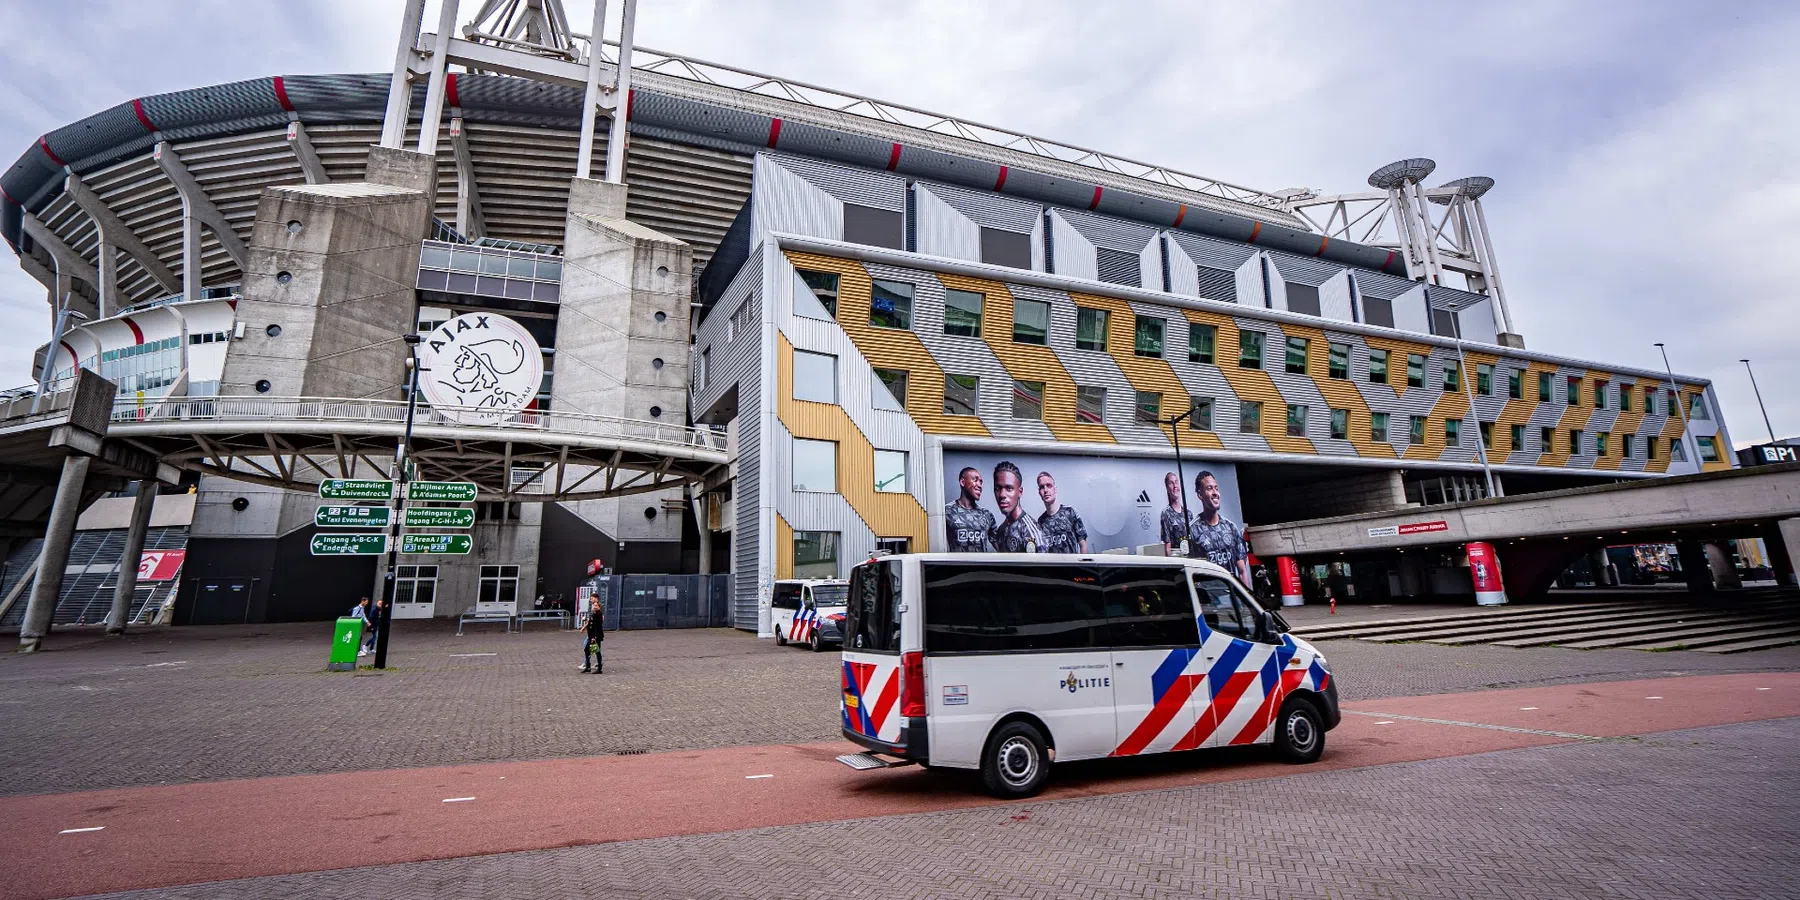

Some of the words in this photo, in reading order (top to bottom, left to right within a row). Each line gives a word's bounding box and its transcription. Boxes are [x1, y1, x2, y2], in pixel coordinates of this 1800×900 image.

[430, 316, 489, 354] AJAX
[1776, 446, 1797, 461] P1
[323, 536, 349, 544] Ingang
[1060, 678, 1110, 693] POLITIE
